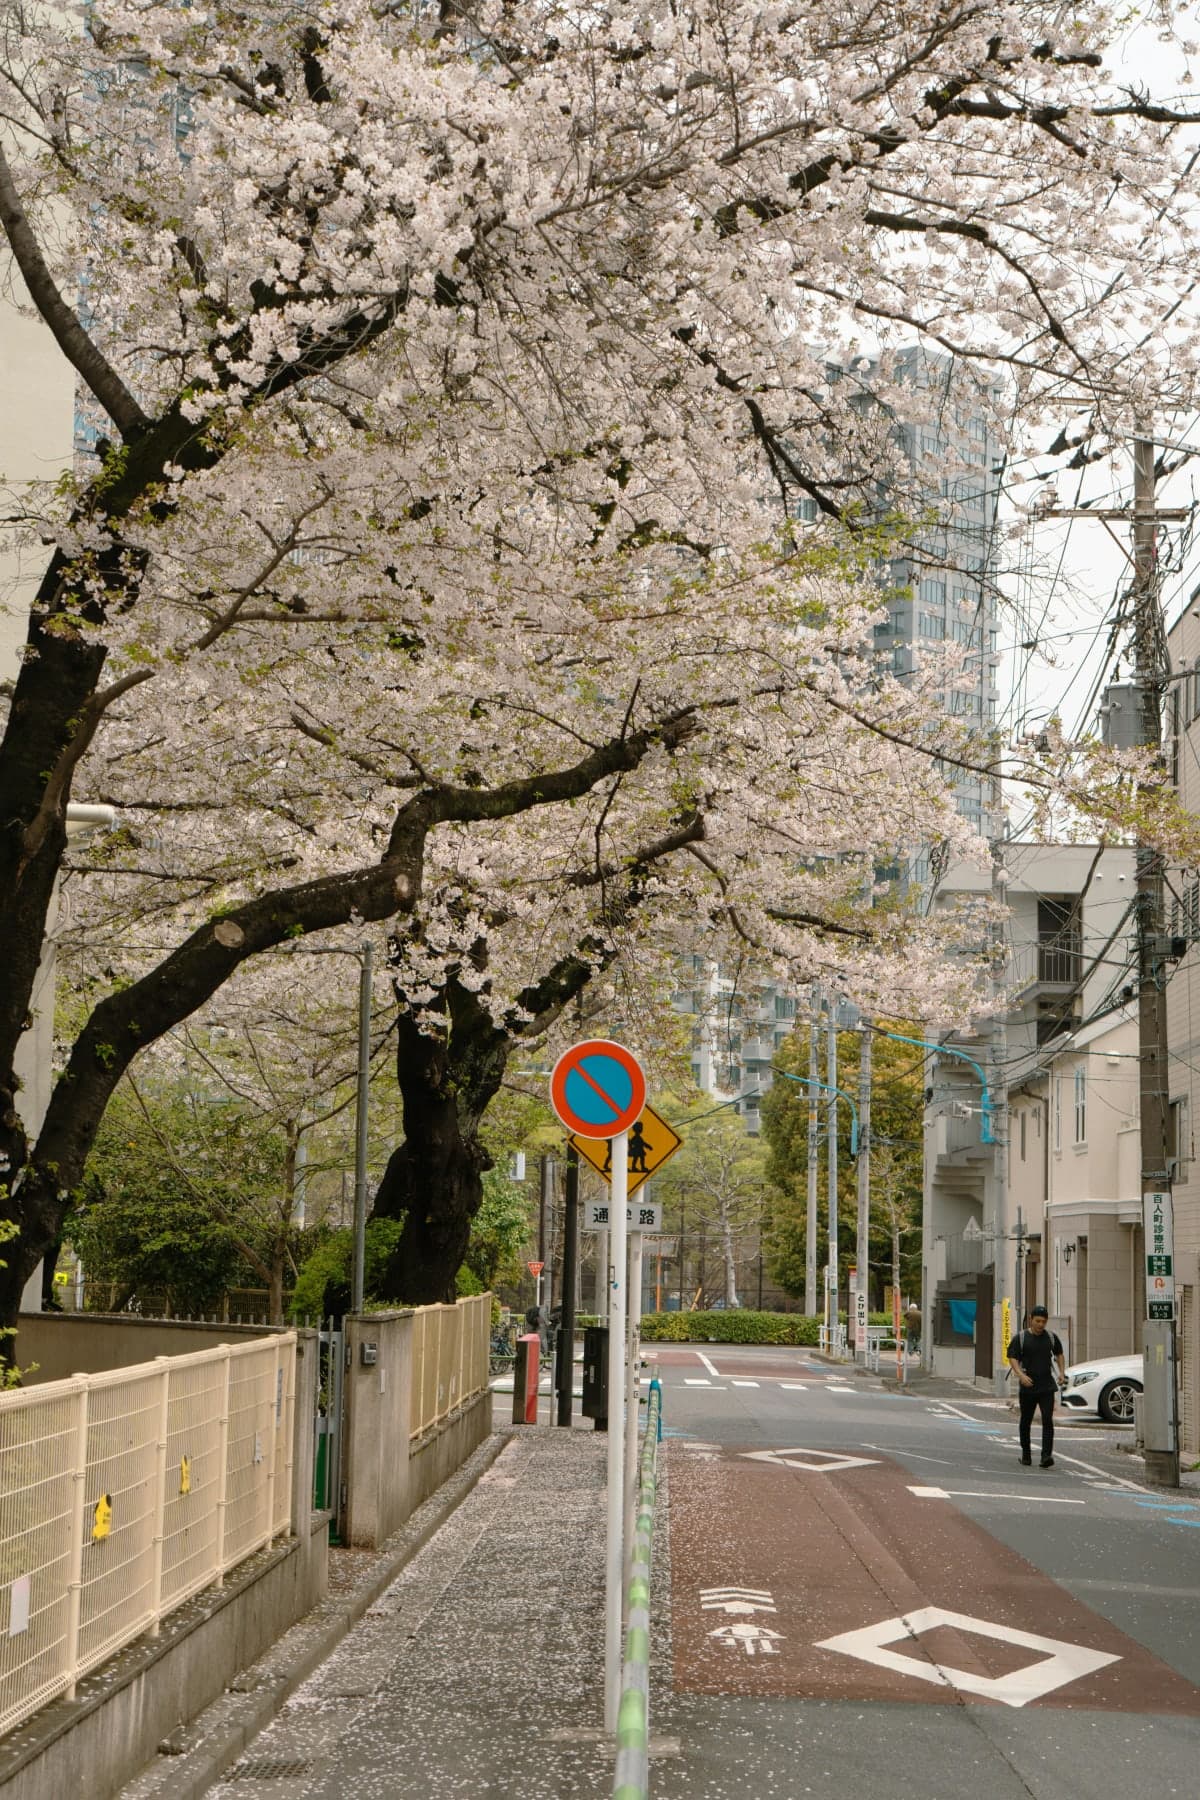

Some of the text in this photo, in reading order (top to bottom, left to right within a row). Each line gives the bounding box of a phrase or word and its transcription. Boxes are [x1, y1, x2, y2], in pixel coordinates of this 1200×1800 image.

[1152, 1193, 1165, 1254] 百人町診療所
